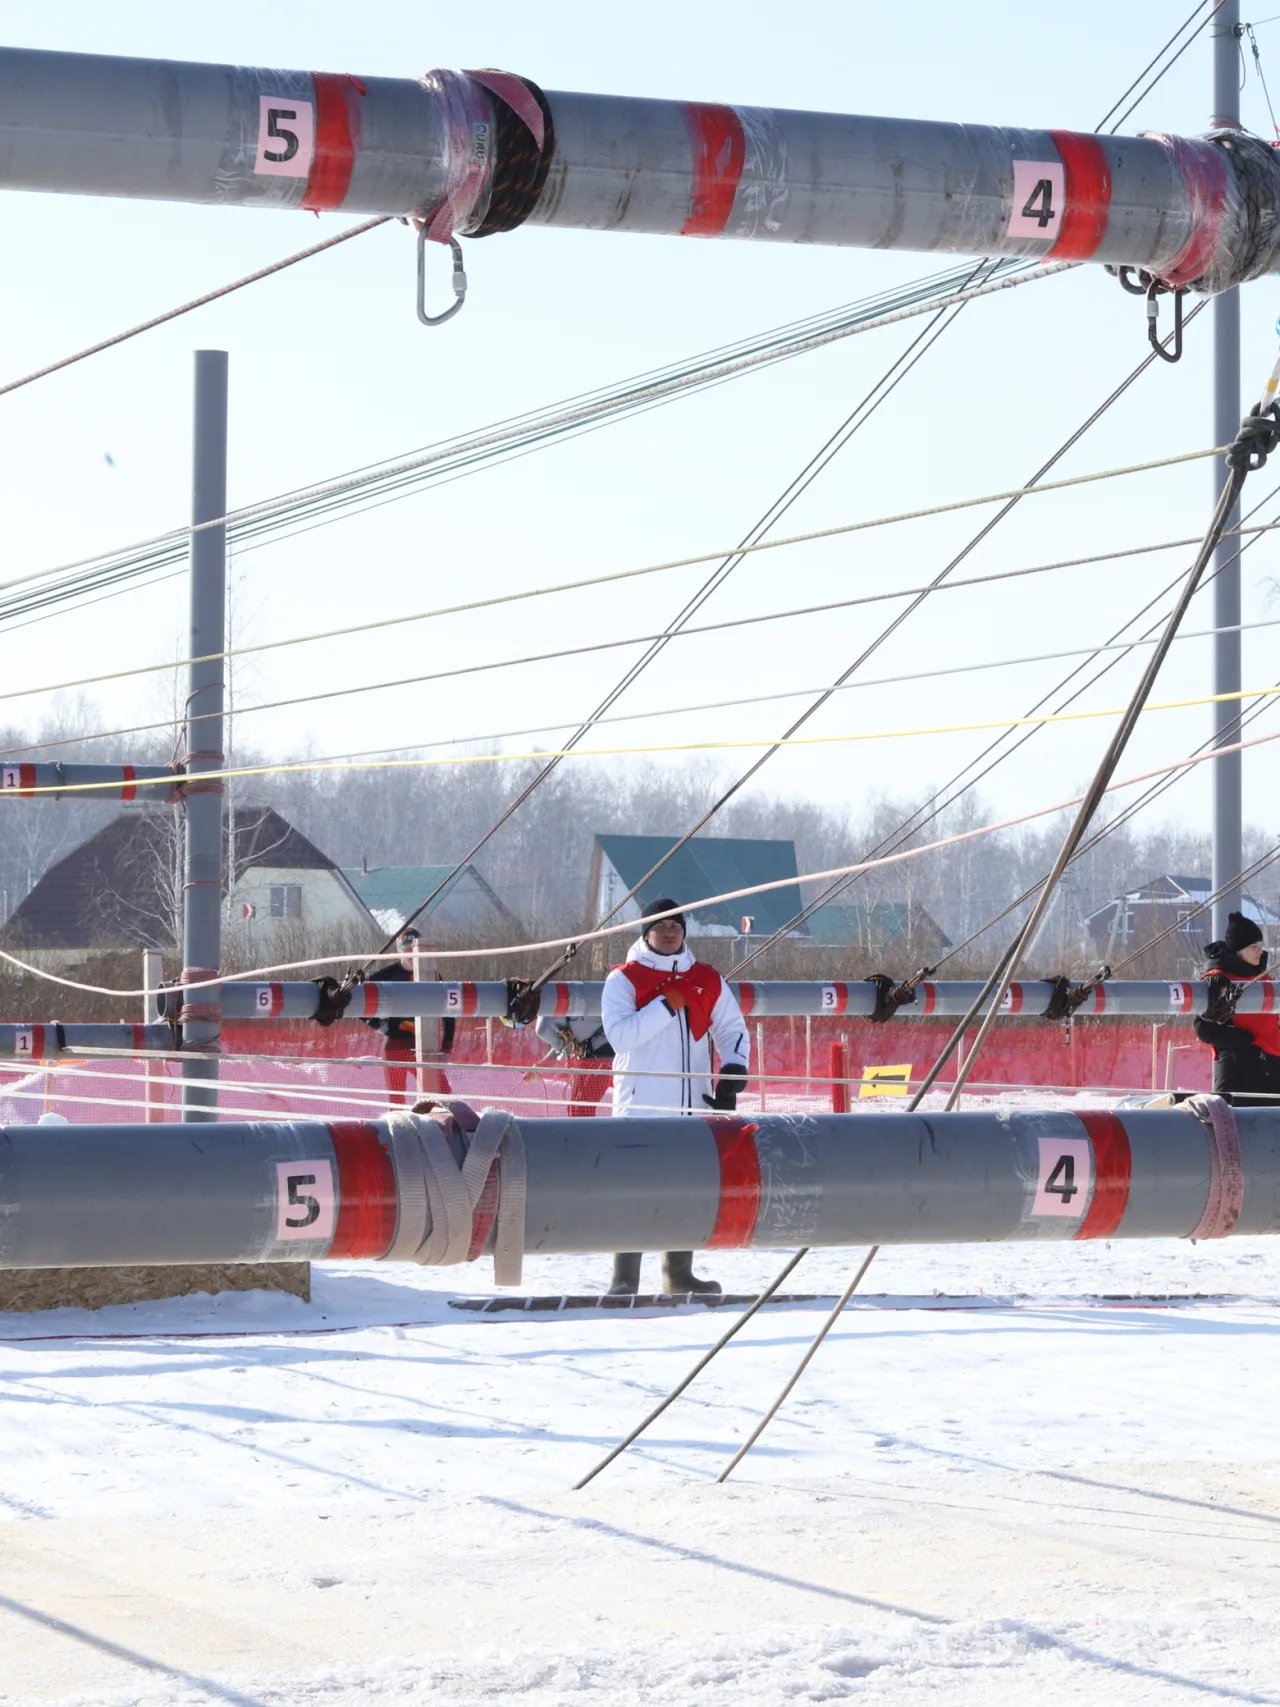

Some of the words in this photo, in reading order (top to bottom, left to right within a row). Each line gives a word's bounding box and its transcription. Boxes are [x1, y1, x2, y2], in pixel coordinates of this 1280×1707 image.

[263, 108, 299, 163] 5
[1021, 178, 1056, 228] 4
[7, 773, 16, 787] 1
[258, 991, 269, 1007] 6
[448, 991, 458, 1006] 5
[824, 991, 834, 1006] 3
[1172, 988, 1181, 1001] 1
[19, 1035, 29, 1051] 1
[1044, 1154, 1078, 1204] 4
[286, 1174, 321, 1229] 5
